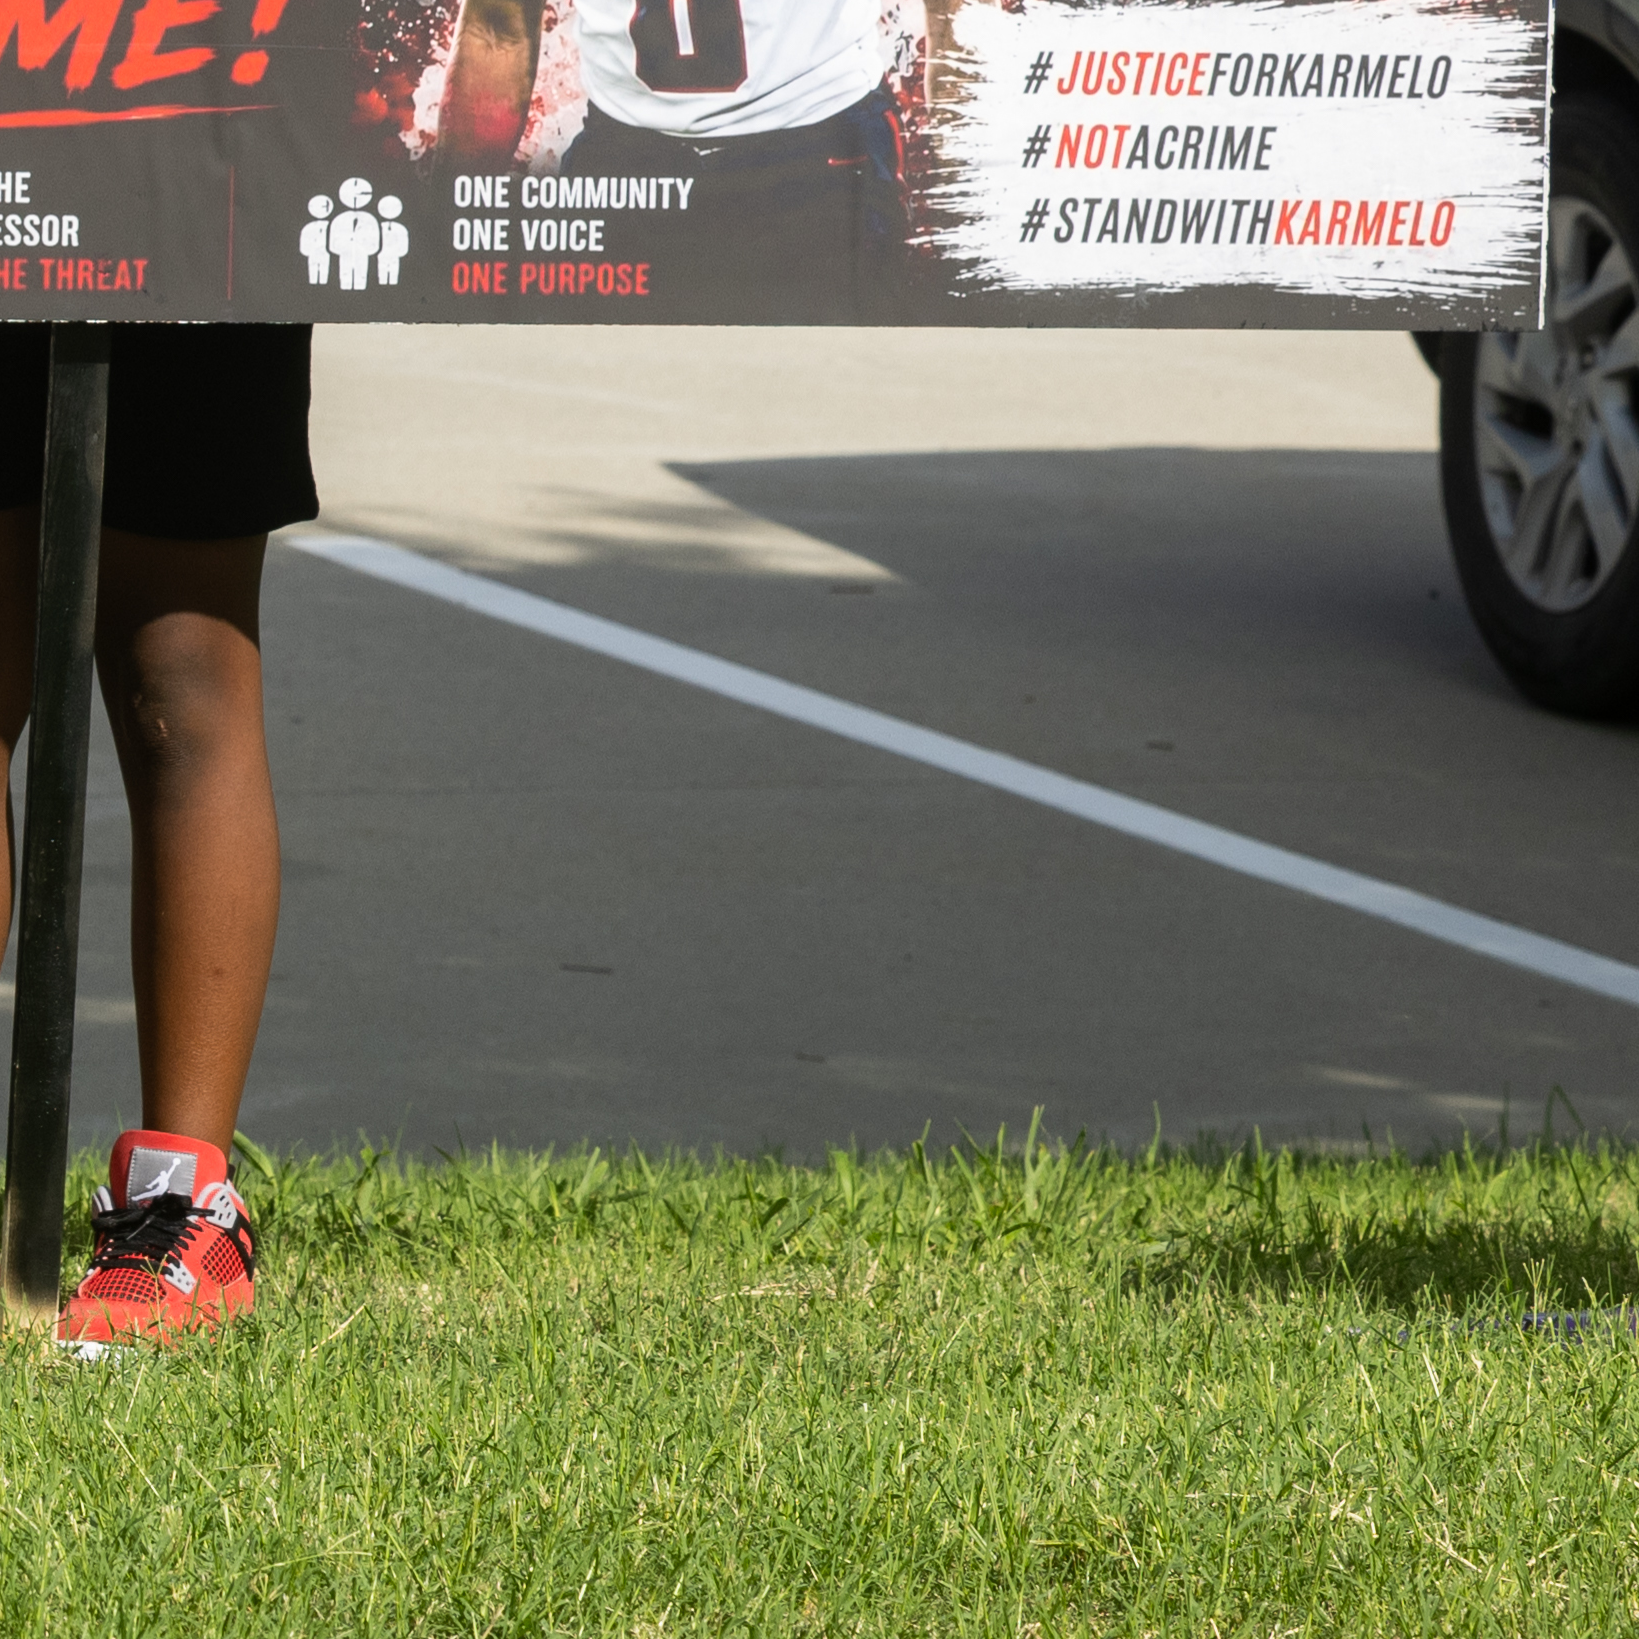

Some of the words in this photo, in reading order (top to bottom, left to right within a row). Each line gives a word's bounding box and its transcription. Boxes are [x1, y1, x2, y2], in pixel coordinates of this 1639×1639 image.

[1023, 51, 1452, 98] #JUSTICEFORKARMELO
[453, 175, 511, 208] ONE
[521, 177, 694, 210] COMMUNITY
[453, 219, 509, 250] ONE
[521, 219, 605, 252] VOICE
[1020, 198, 1455, 247] #STANDWITHKARMELO
[39, 259, 148, 291] THREAT
[451, 262, 508, 294] ONE
[520, 262, 650, 295] PURPOSE
